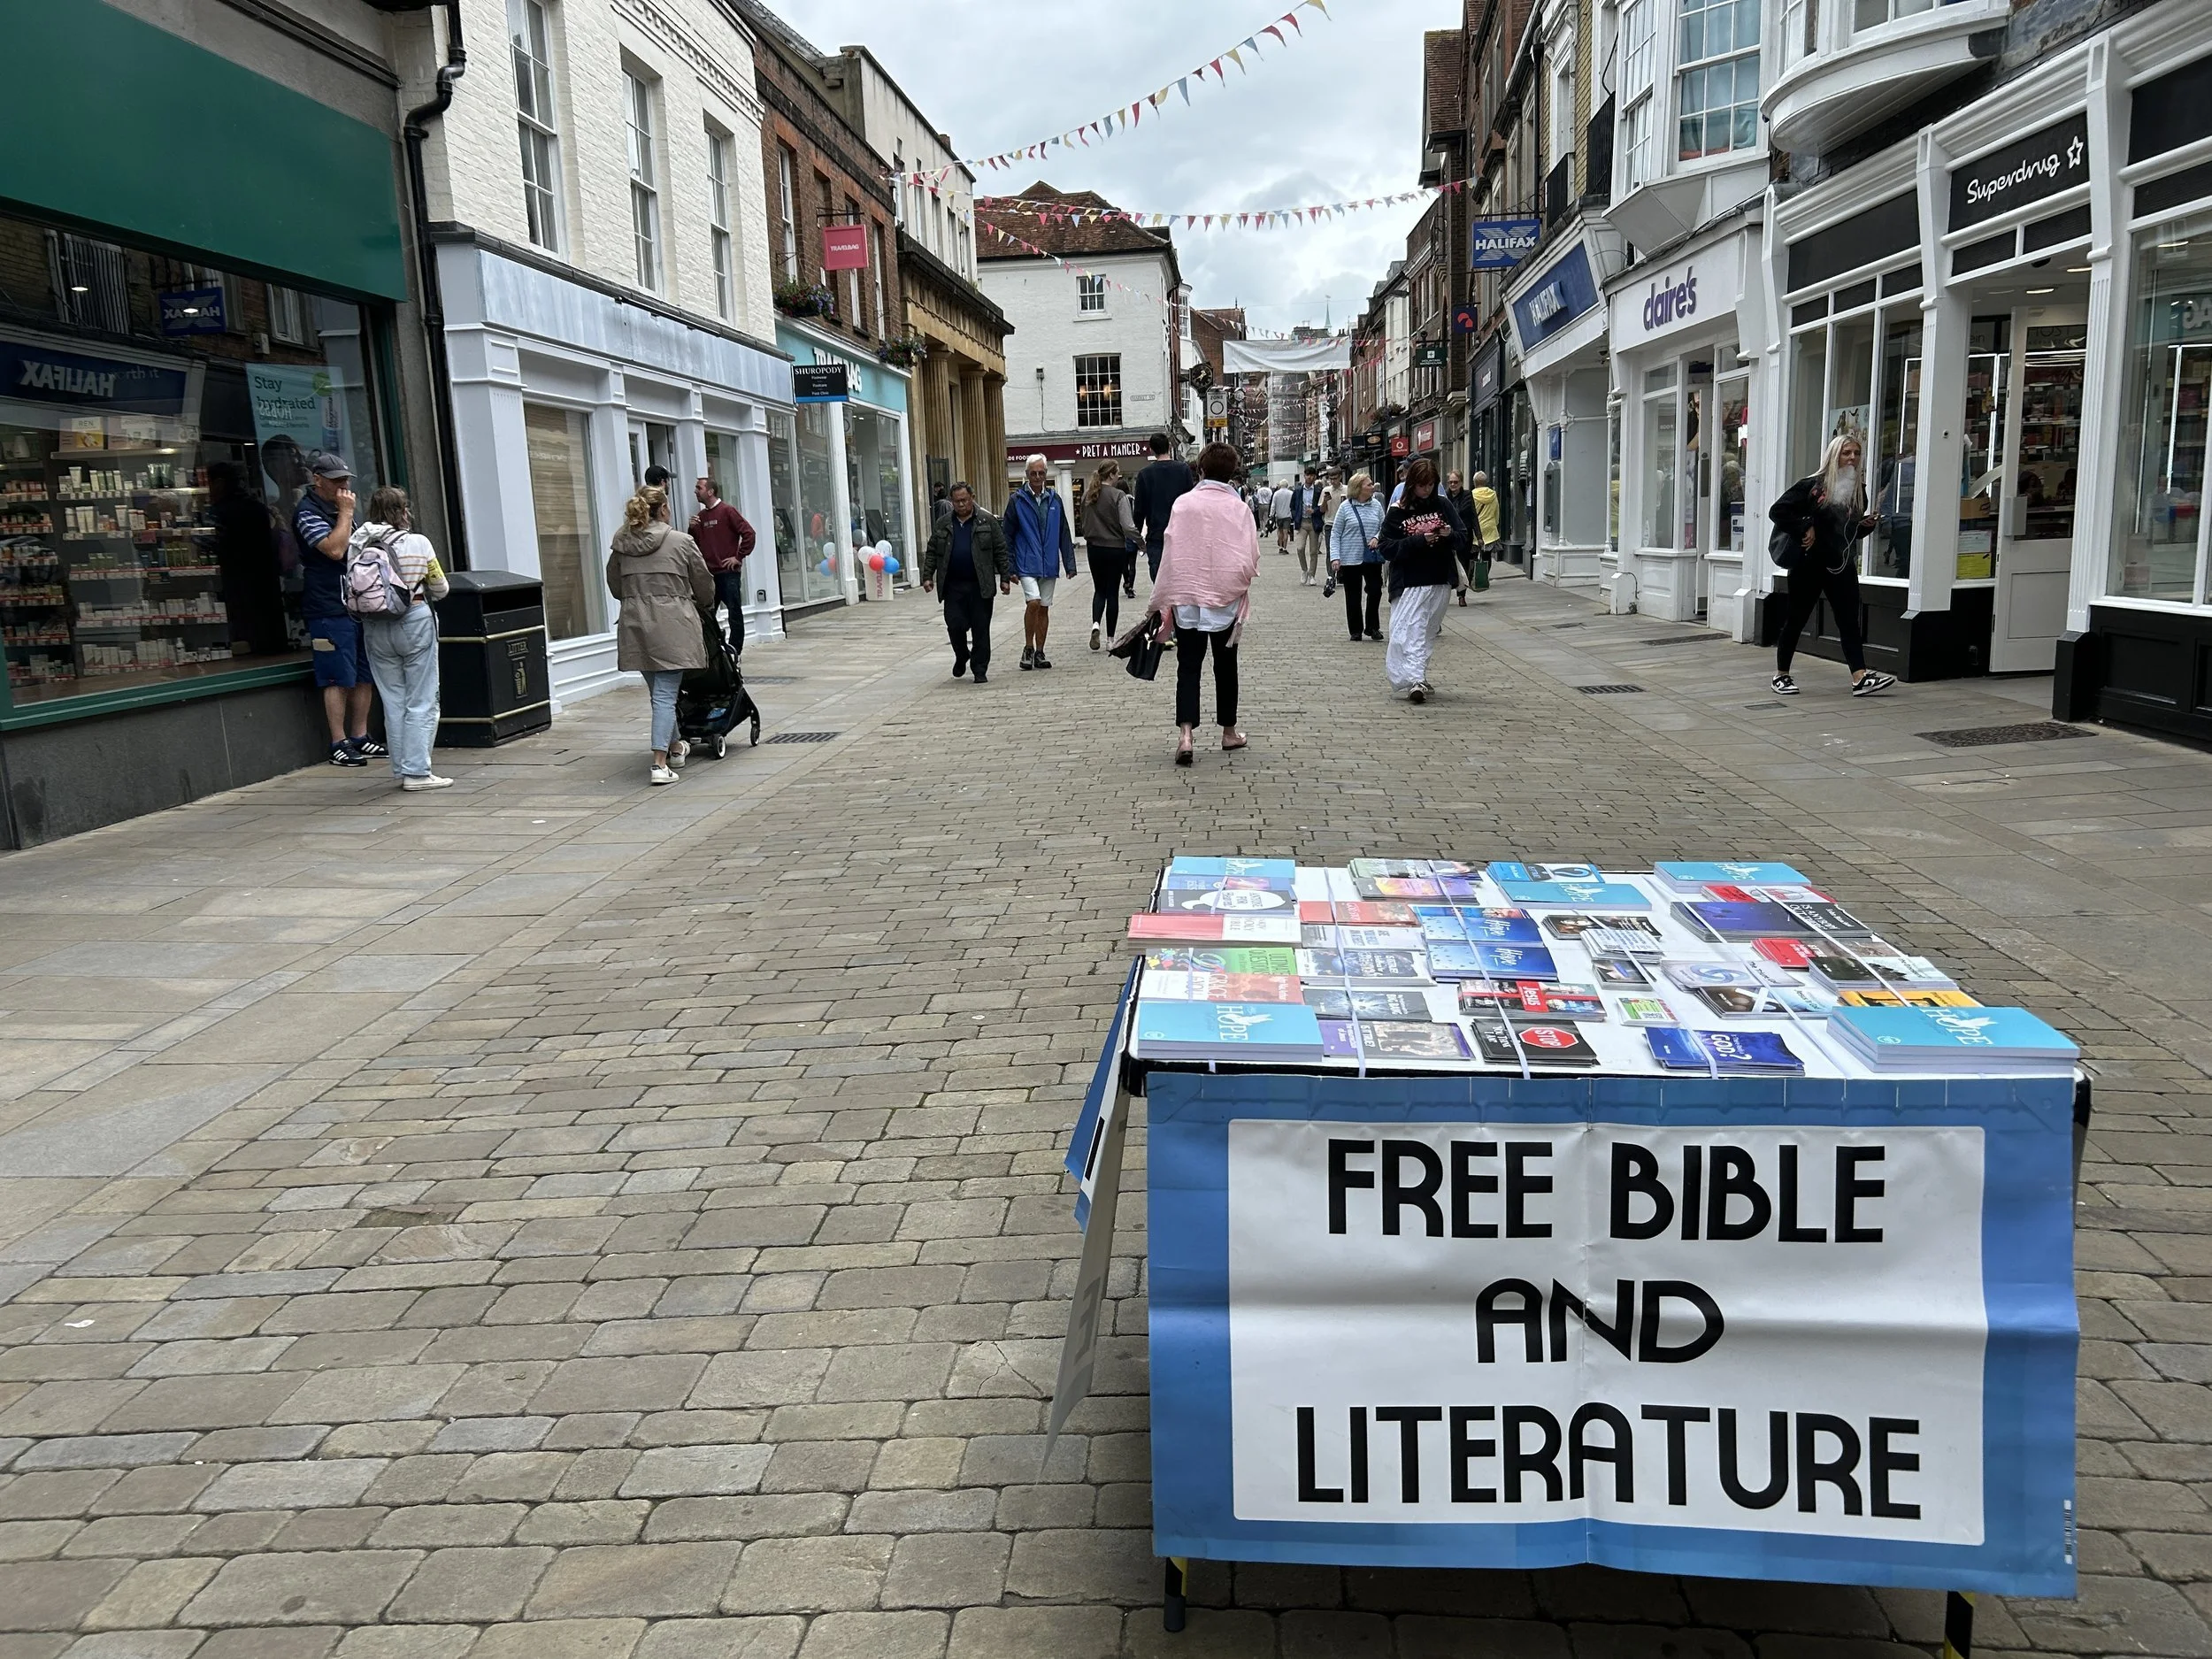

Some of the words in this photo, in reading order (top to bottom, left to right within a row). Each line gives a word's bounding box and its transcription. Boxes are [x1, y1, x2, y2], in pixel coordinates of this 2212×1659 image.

[1966, 153, 2061, 204] Superdrug
[830, 243, 860, 252] TRAVELBAG
[1475, 235, 1536, 251] HALIFAX
[1528, 280, 1564, 328] HALIFAX
[1643, 265, 1698, 332] claire's
[795, 365, 842, 376] SHUROPODY
[254, 375, 282, 393] Stay
[1082, 445, 1101, 458] PRET
[1102, 446, 1109, 457] A
[1111, 442, 1141, 457] MANGER
[1402, 516, 1416, 527] THE
[508, 641, 529, 654] LITTER
[1558, 883, 1594, 902] HOPE
[1208, 973, 1228, 999] GRACE
[1523, 986, 1541, 1007] Jesus
[1216, 1004, 1248, 1041] HOPE
[1492, 1025, 1506, 1035] YOU
[1919, 1008, 1994, 1046] HOPE
[1363, 1033, 1375, 1048] TRUE?
[1534, 1028, 1562, 1048] STOP
[1710, 1033, 1752, 1061] GOD?
[1328, 1138, 1554, 1239] FREE
[1609, 1141, 1886, 1243] BIBLE
[1475, 1278, 1725, 1363] AND
[1296, 1402, 1921, 1520] LITERATURE
